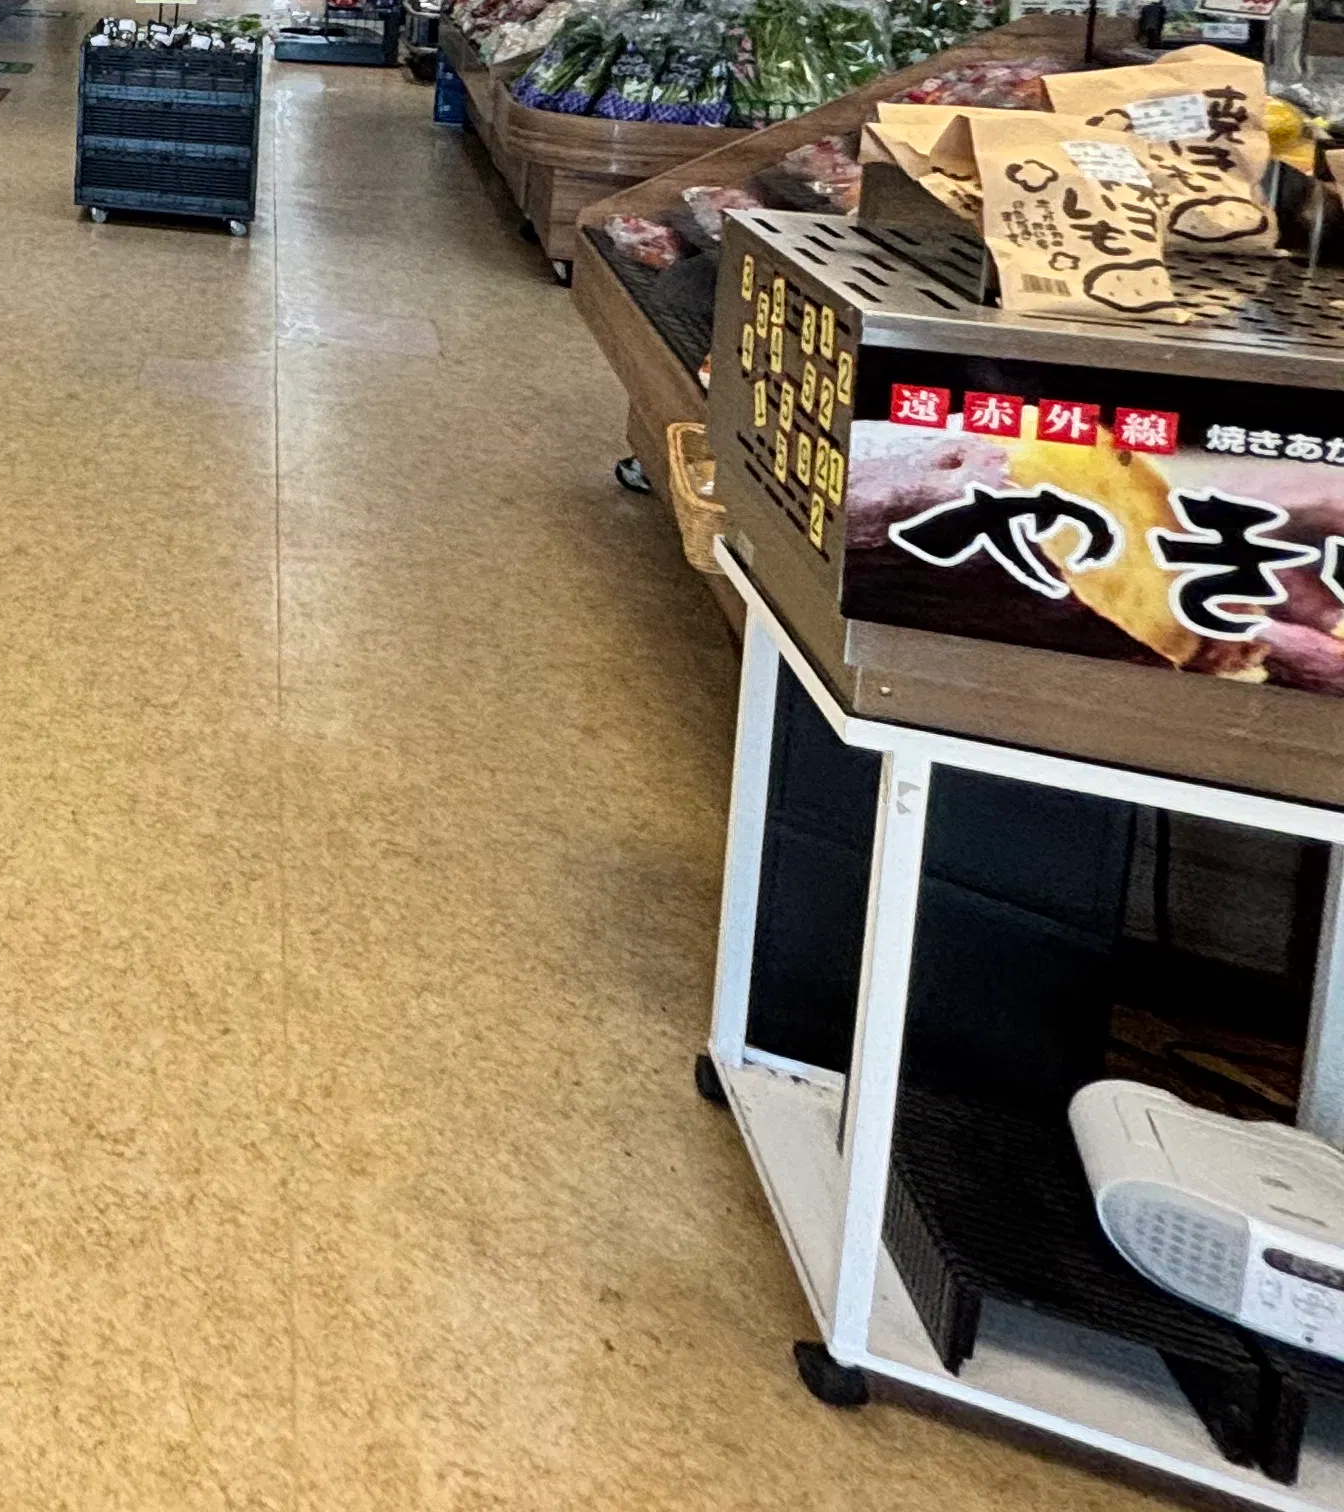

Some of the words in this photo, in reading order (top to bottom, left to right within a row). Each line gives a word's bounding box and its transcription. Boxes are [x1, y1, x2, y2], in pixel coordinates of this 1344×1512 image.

[896, 388, 1170, 451] 遠赤外線
[887, 480, 1344, 641] やき
